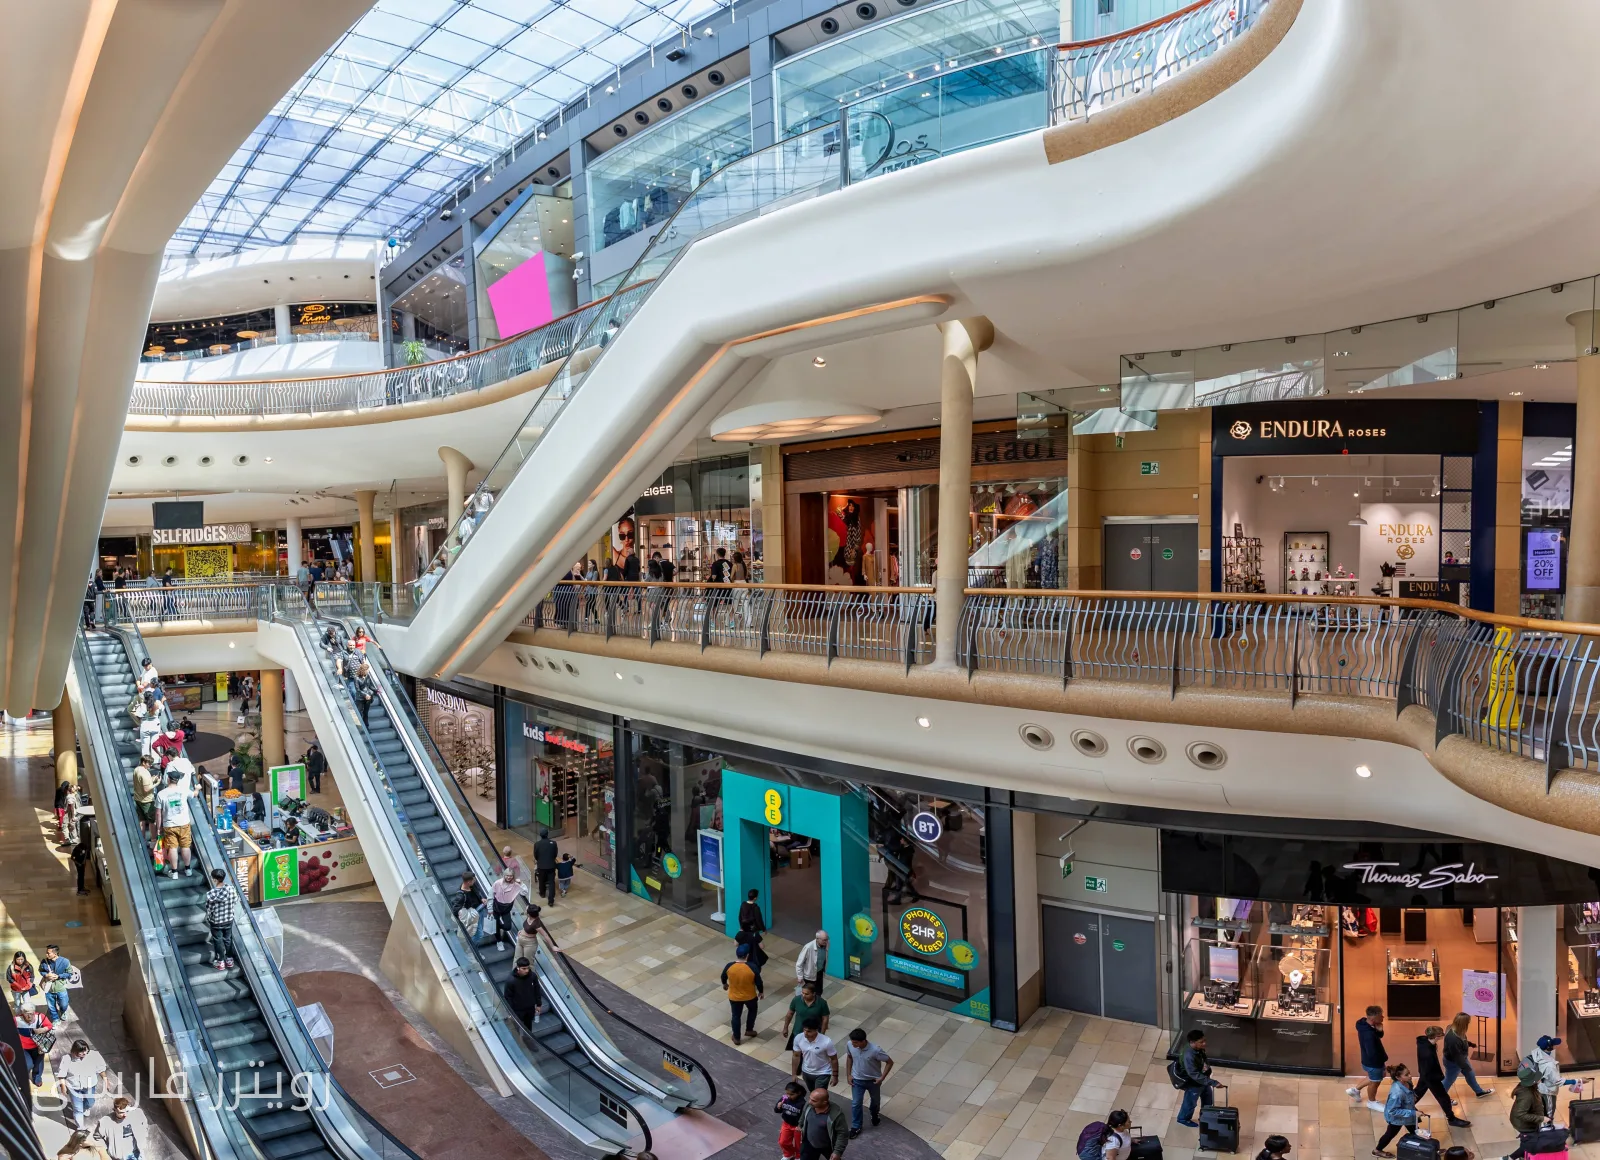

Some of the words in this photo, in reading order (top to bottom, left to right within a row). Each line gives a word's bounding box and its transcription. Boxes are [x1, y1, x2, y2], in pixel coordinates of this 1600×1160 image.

[300, 312, 331, 323] Fumo
[1260, 420, 1344, 438] ENDURA
[1348, 428, 1387, 437] ROSES
[641, 485, 673, 497] EIGER
[153, 525, 226, 544] SELFRIDGES
[1379, 523, 1433, 536] ENDURA
[1534, 559, 1554, 568] 20%
[1533, 568, 1554, 577] OFF
[1409, 582, 1451, 592] ENDURA
[523, 722, 545, 742] kids
[918, 820, 935, 834] BT
[340, 856, 364, 870] good!
[275, 854, 292, 894] BOOST
[1343, 862, 1422, 888] Thomas
[1418, 862, 1499, 889] Sabo
[906, 910, 941, 928] PHONES
[911, 924, 936, 940] 2HR
[904, 931, 943, 953] REPAIRED
[890, 958, 903, 966] YOUR
[903, 961, 920, 970] PHONE
[1478, 989, 1492, 998] 15%
[969, 1000, 989, 1012] BIG
